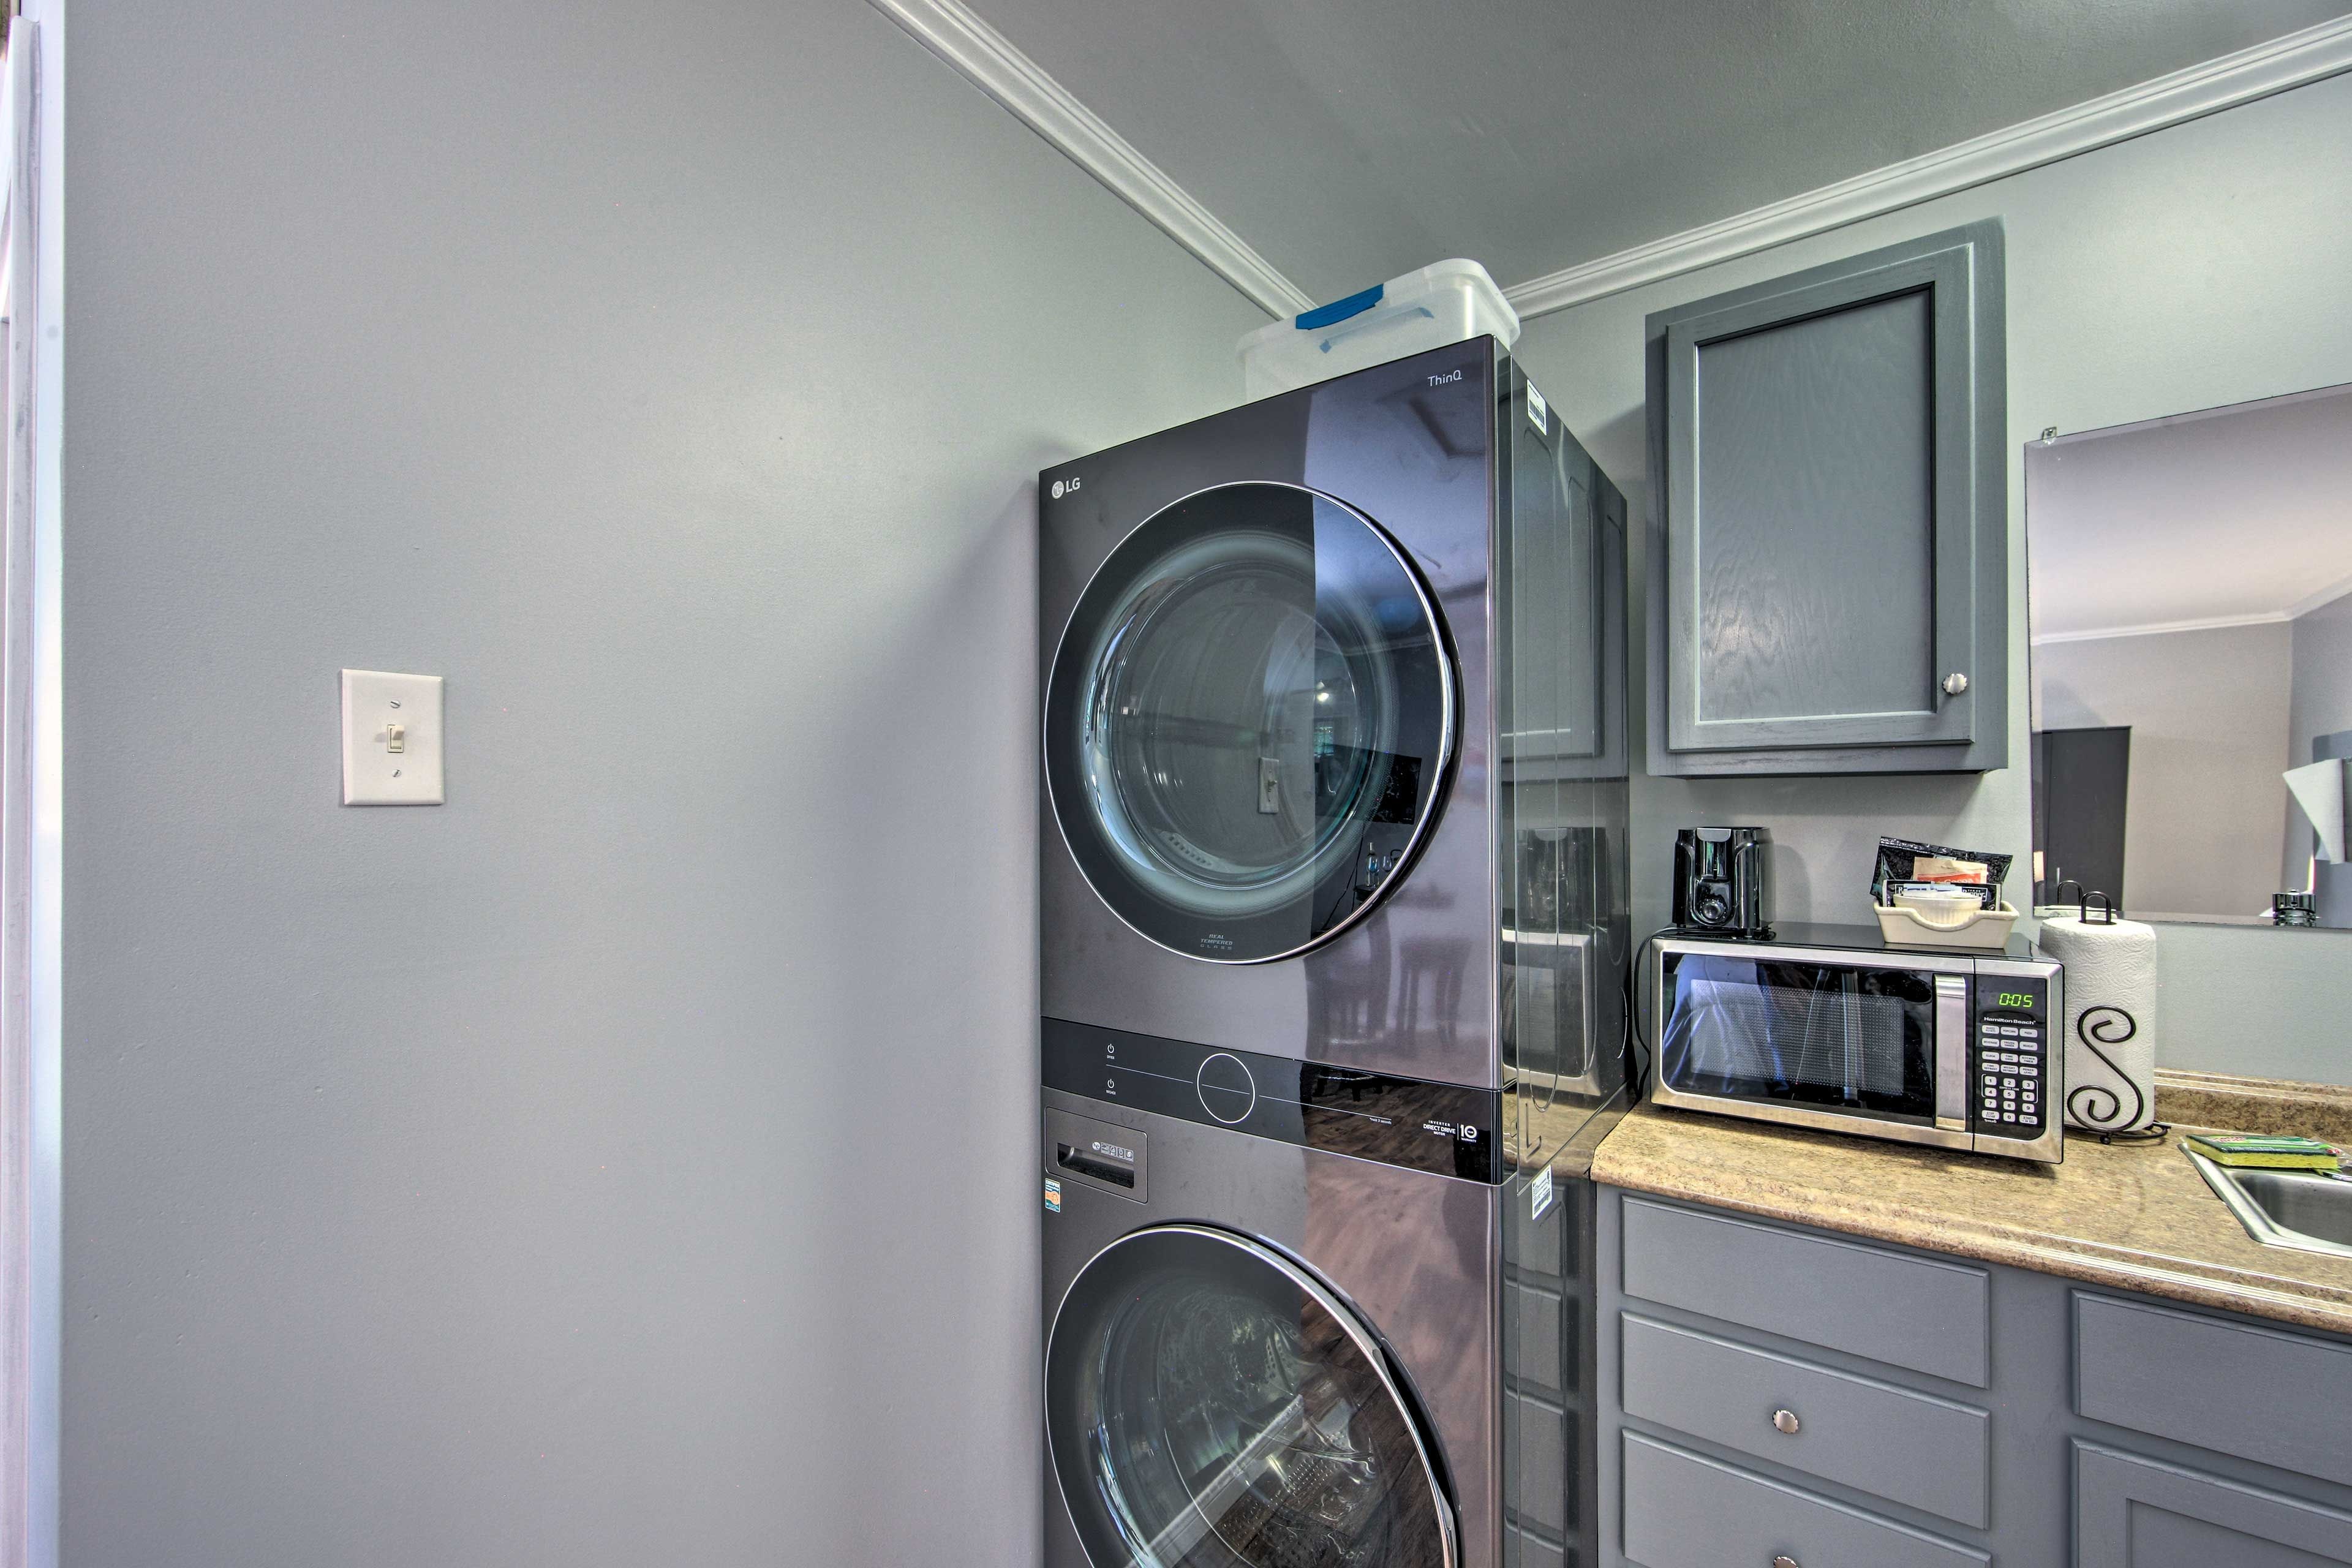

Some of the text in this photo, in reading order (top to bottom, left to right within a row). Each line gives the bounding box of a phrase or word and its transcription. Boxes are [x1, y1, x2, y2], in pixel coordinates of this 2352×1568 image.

[1427, 369, 1462, 386] ThinQ
[1066, 477, 1080, 493] LG
[1999, 993, 2034, 1008] 0:05
[1423, 1123, 1441, 1132] DIRECT
[1460, 1124, 1477, 1139] 10
